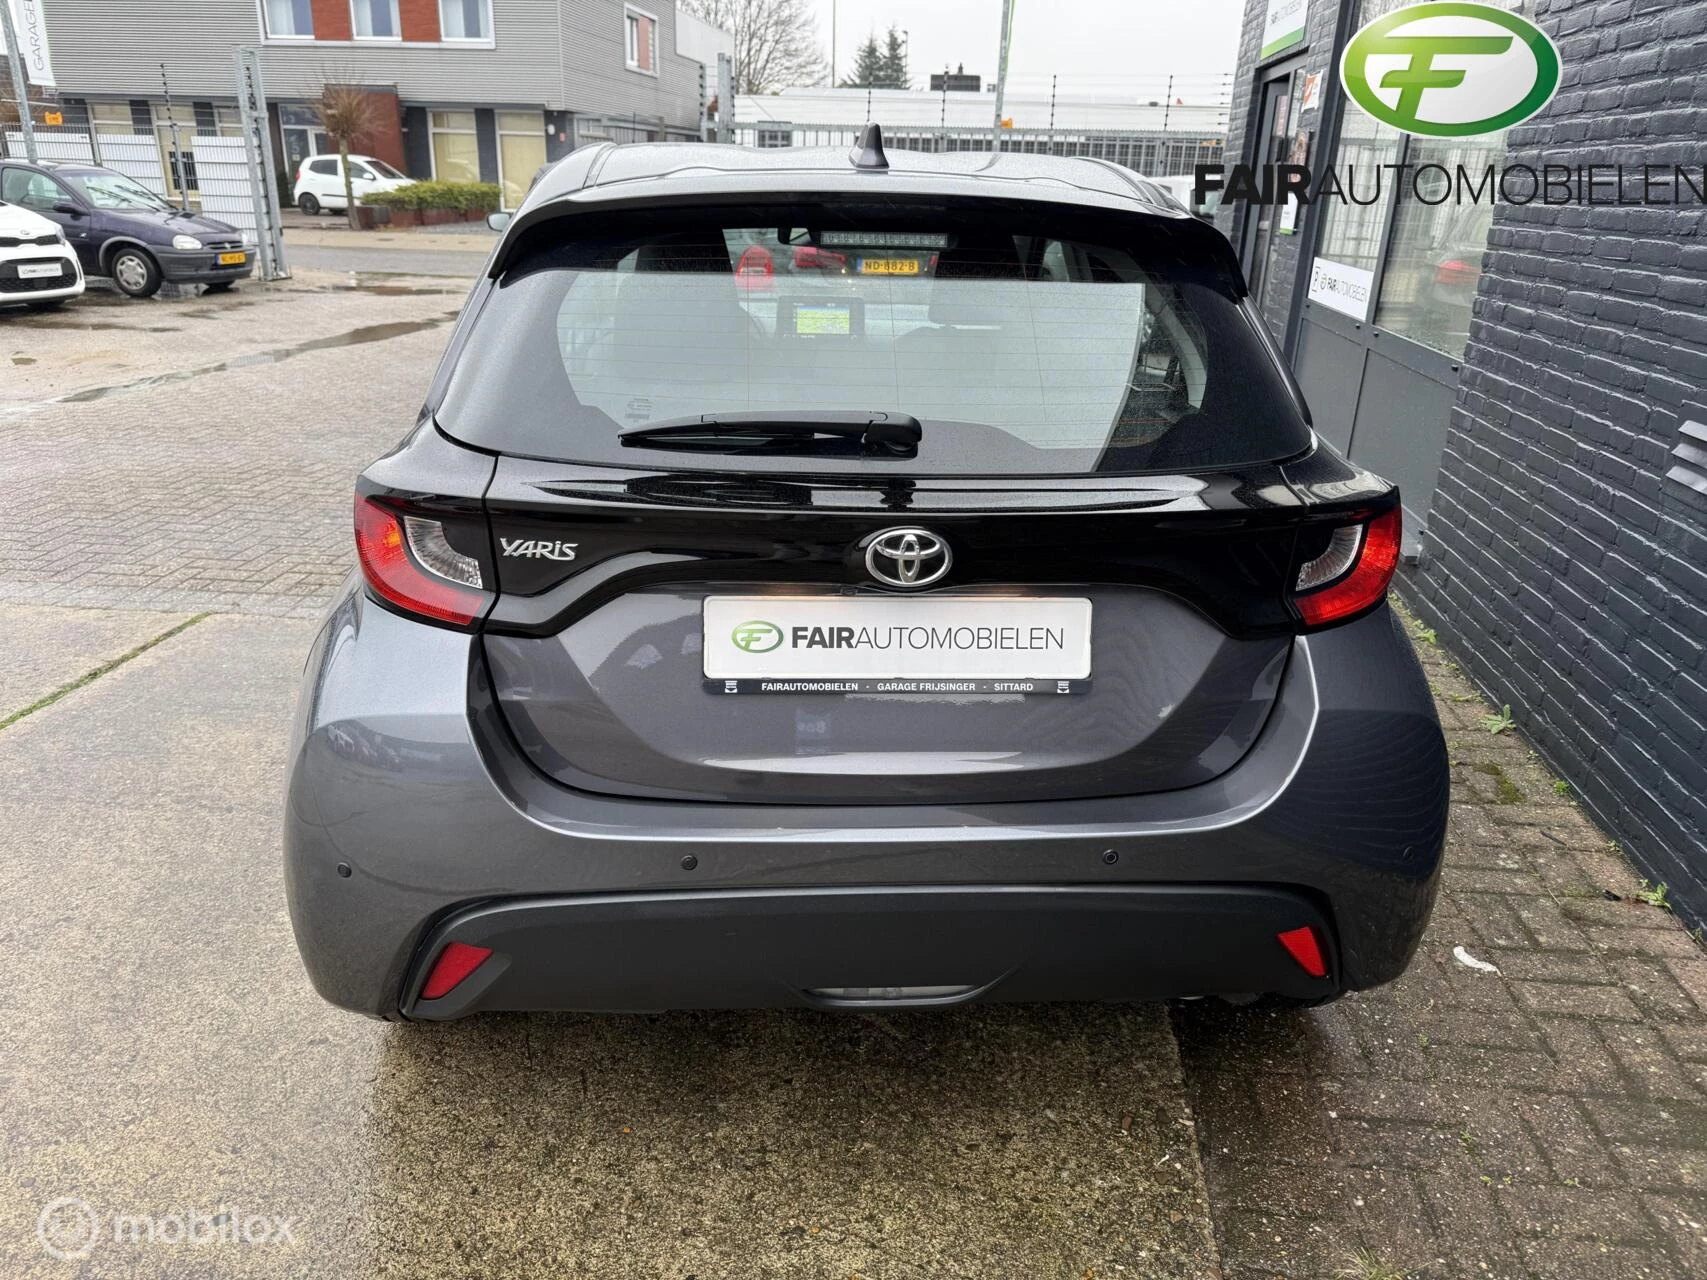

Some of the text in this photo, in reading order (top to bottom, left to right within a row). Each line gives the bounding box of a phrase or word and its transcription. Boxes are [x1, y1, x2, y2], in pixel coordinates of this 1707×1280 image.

[791, 626, 1065, 650] FAIRAUTOMOBIELEN
[761, 682, 1034, 692] FAIRAUTOMOBIELEN GARAGE FRIJSINGER SITTARD
